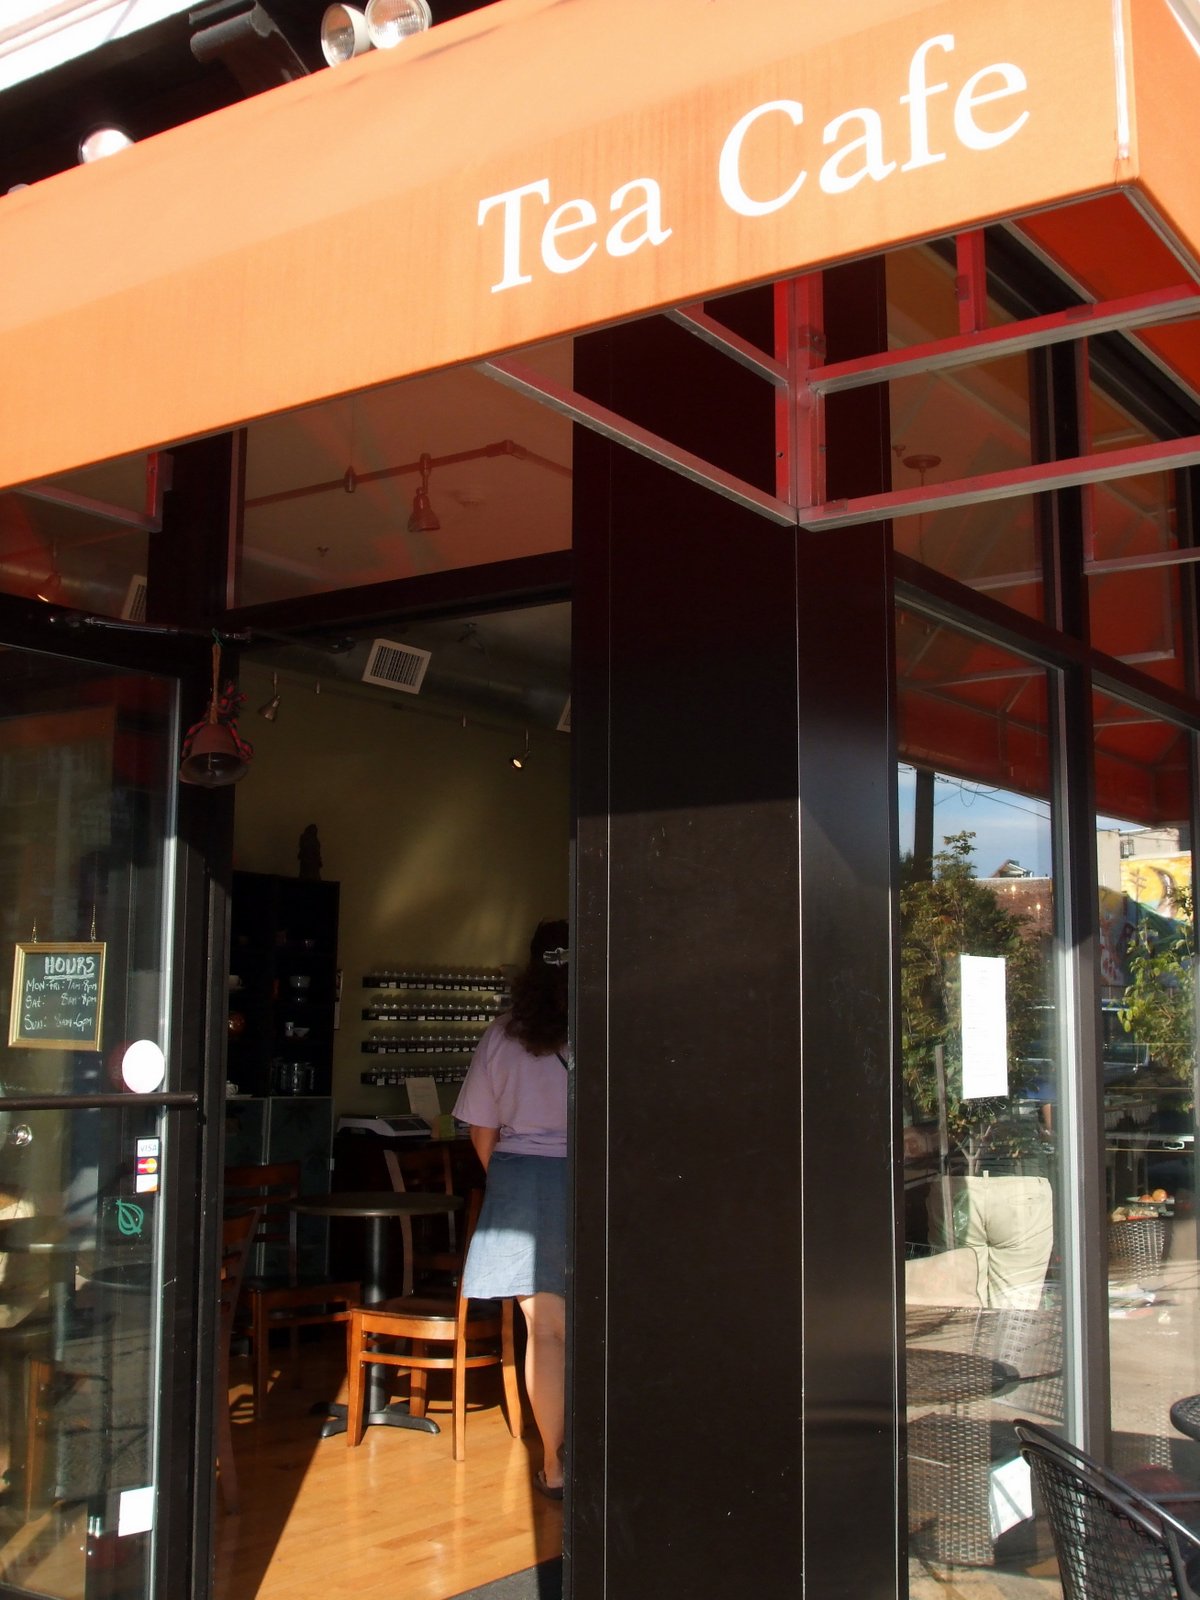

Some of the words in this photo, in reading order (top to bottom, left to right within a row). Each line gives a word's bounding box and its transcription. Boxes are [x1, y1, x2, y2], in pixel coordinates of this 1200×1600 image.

[477, 178, 672, 294] Tea
[718, 33, 1030, 217] Cafe
[44, 956, 95, 975] HOURS
[140, 1144, 157, 1152] VISA
